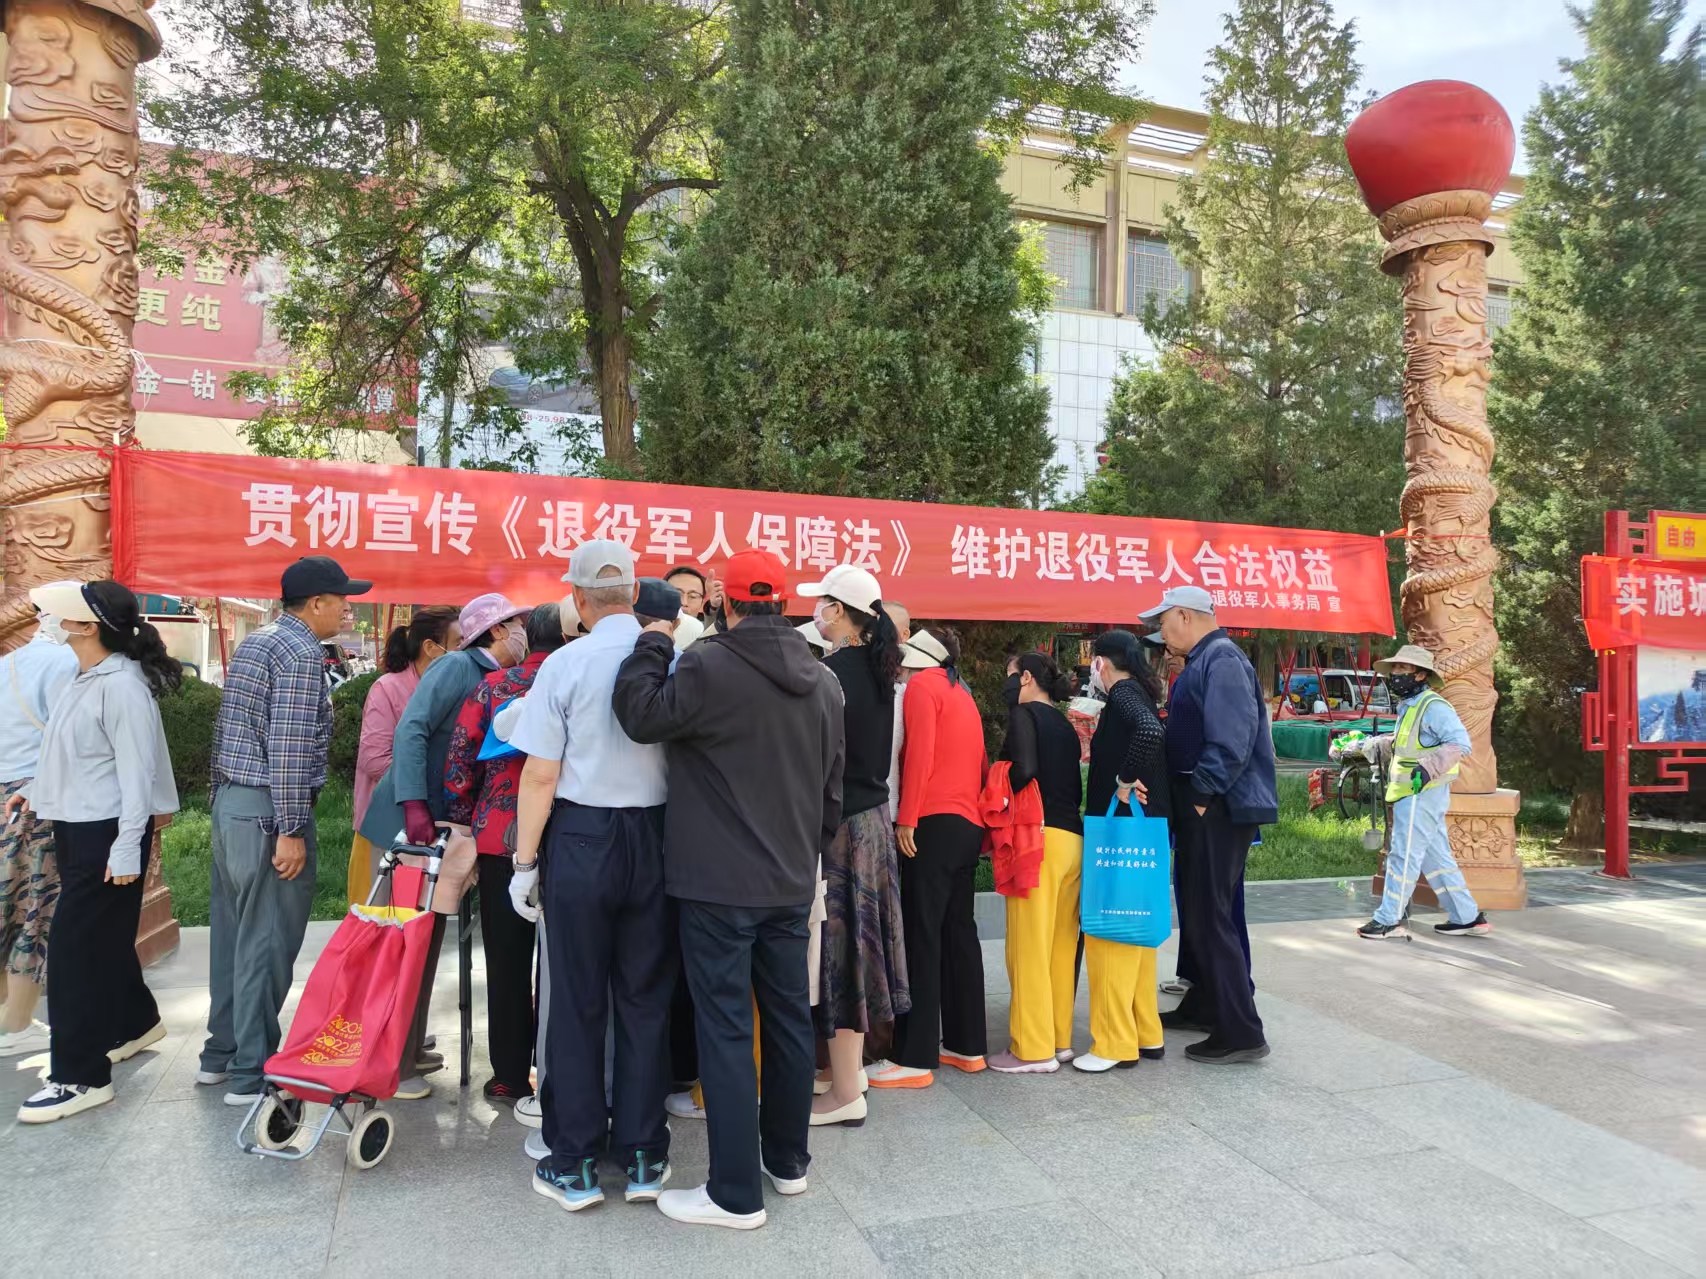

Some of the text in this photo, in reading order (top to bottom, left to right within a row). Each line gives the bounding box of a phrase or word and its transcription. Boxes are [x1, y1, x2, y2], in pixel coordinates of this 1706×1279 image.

[136, 287, 223, 332] 更纯
[241, 482, 1339, 593] 贯彻宣传《退役军人保障法》 维护退役军人合法权益
[1666, 525, 1696, 549] 自由
[1327, 595, 1342, 613] 宣
